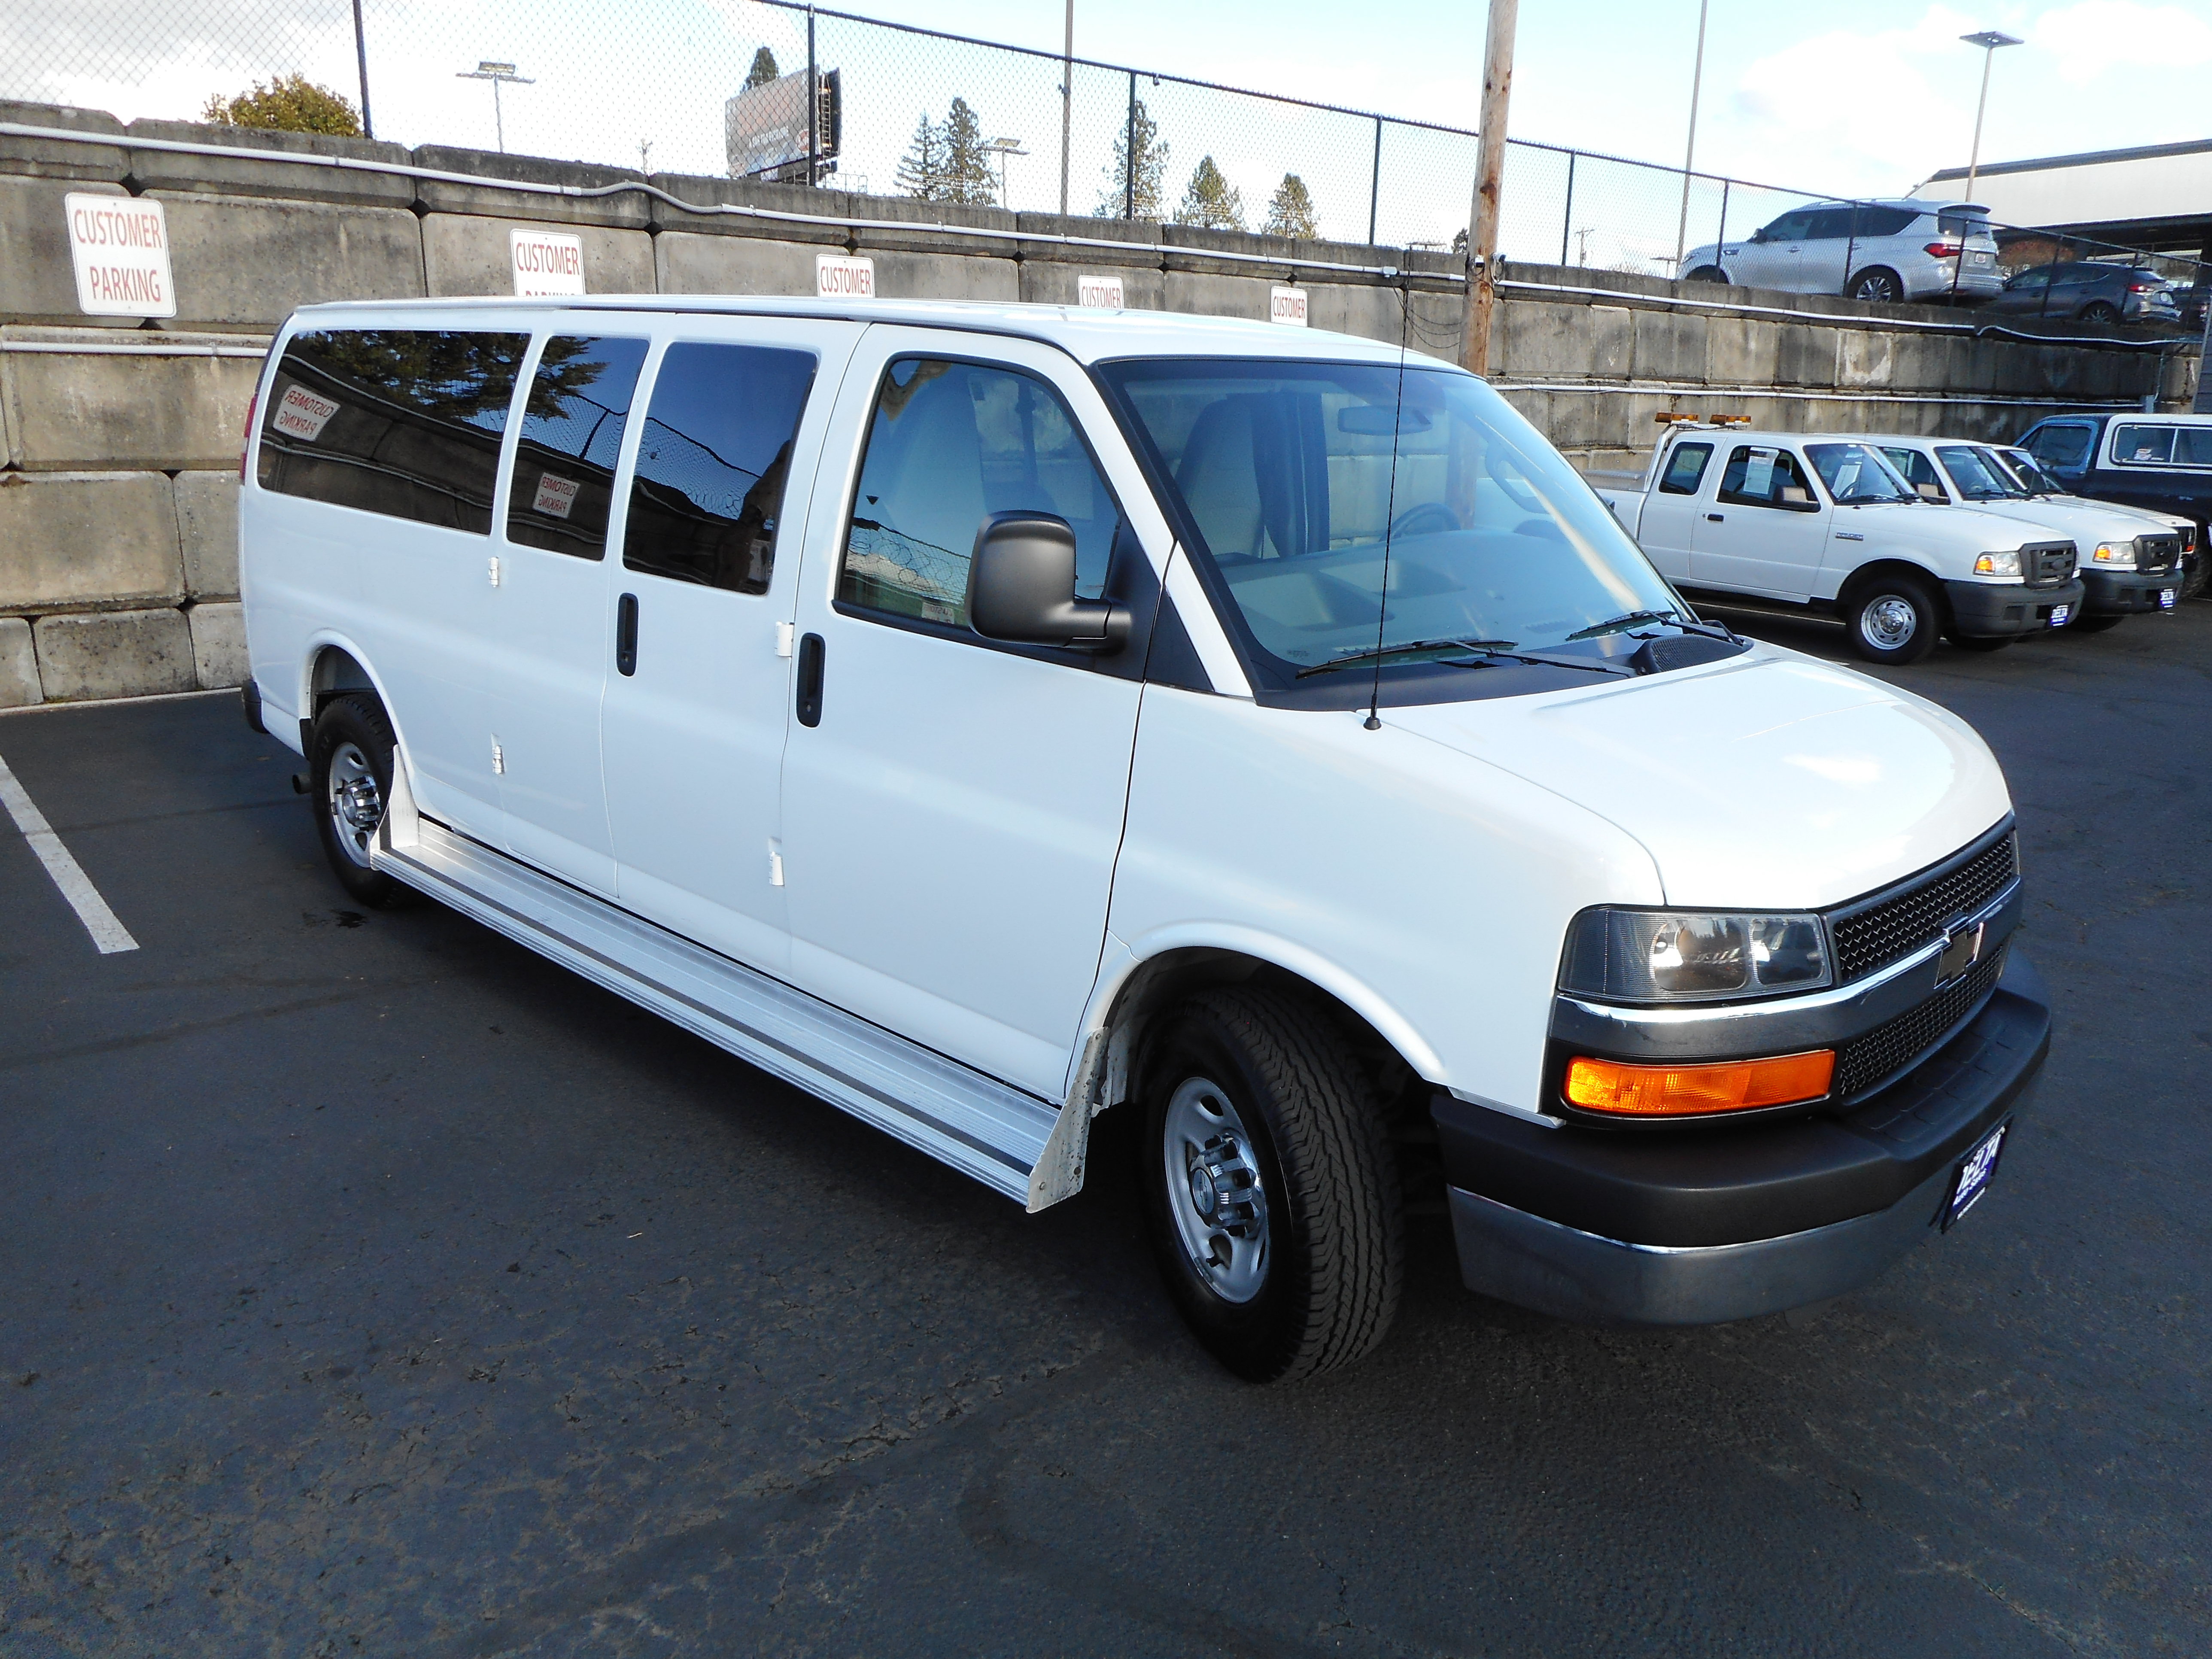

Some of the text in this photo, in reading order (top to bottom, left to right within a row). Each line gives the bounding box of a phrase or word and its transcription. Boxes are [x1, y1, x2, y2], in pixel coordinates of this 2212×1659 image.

[74, 209, 163, 248] CUSTOMER
[516, 242, 580, 275] CUSTOMER
[89, 266, 162, 302] PARKING
[820, 266, 872, 295] CUSTOMER
[1082, 285, 1121, 309] CUSTOMER
[1273, 295, 1305, 319] CUSTOMER
